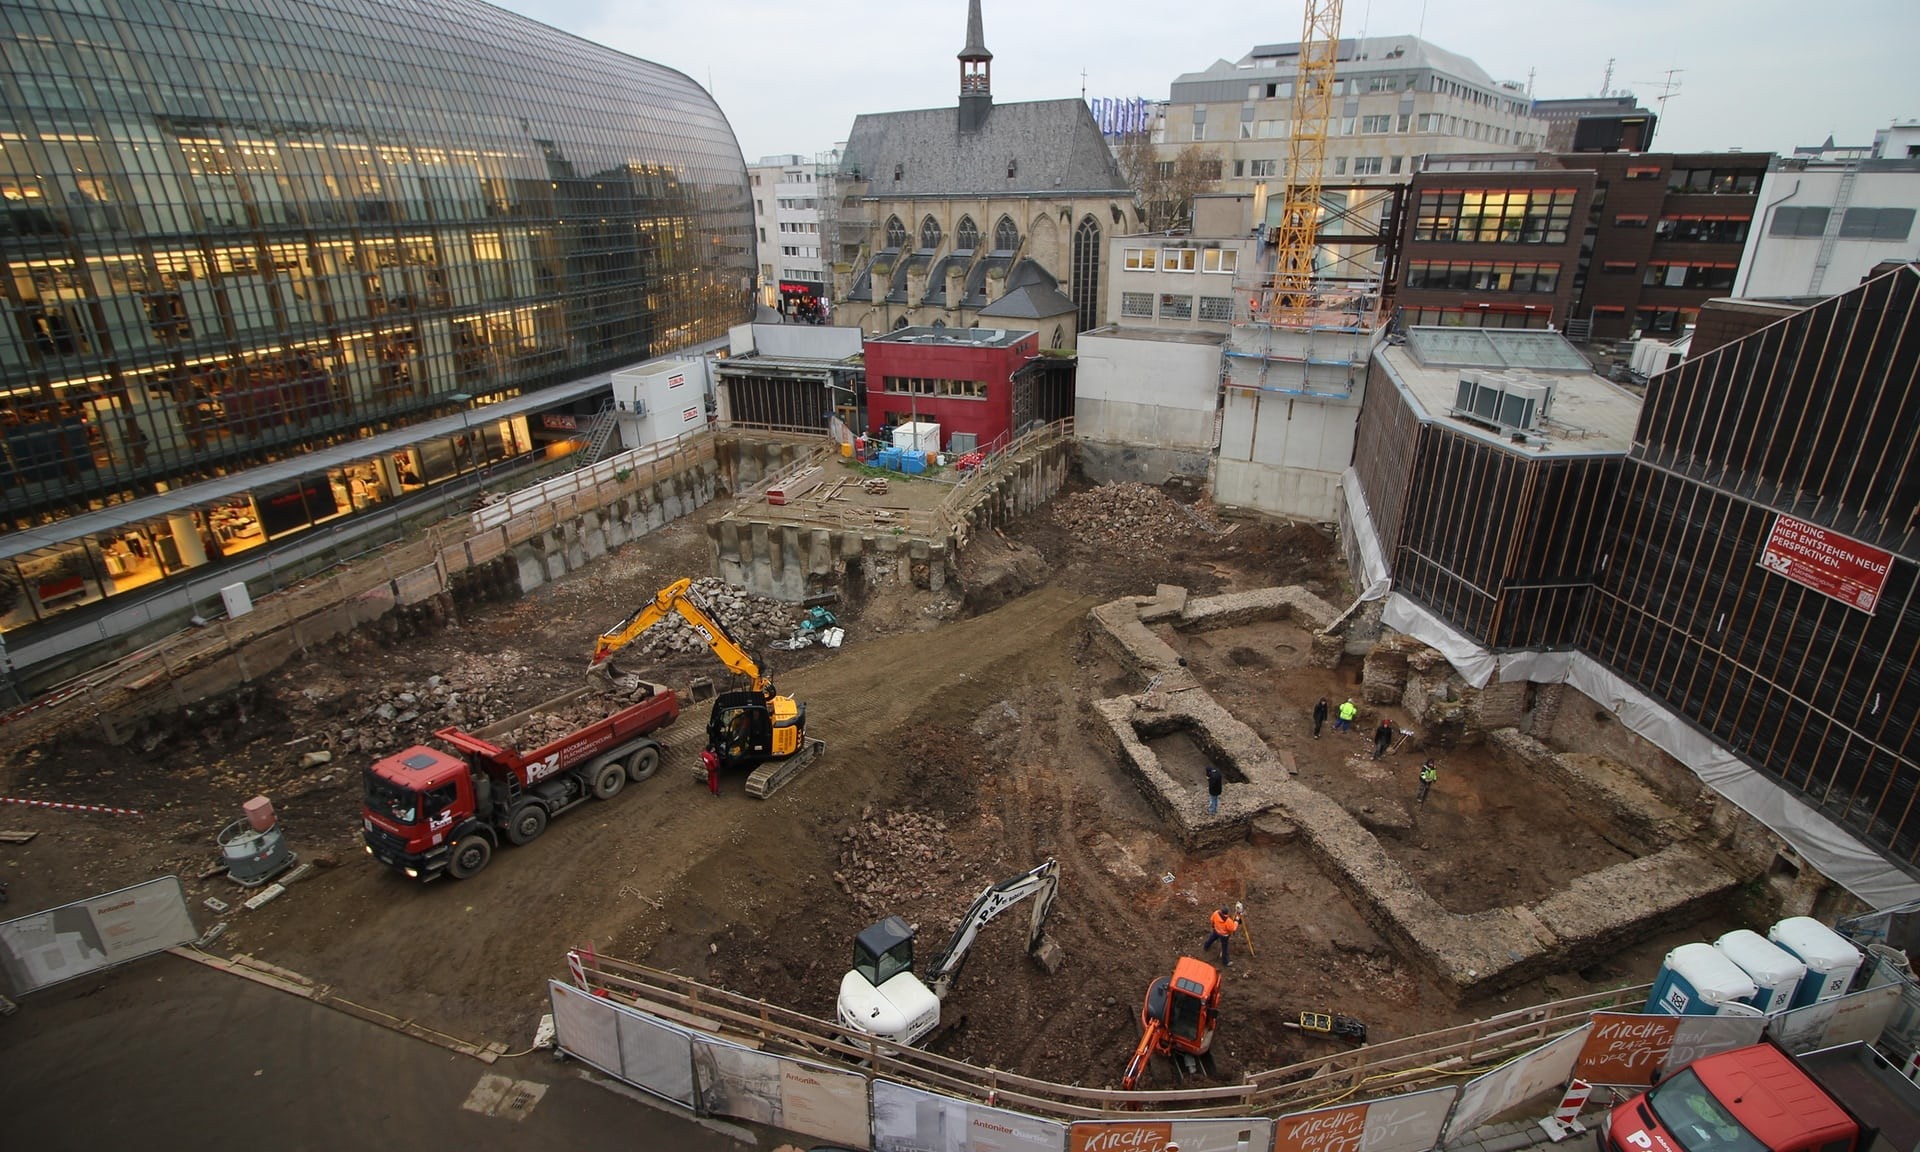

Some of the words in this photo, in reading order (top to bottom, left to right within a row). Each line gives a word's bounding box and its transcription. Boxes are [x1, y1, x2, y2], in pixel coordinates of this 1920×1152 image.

[1778, 516, 1825, 540] ACHTUNG.
[1771, 535, 1840, 569] PERSPEKTIVEN.
[1775, 526, 1798, 540] HIER
[1799, 536, 1854, 562] ENTSTEHEN
[1855, 557, 1886, 575] NEUE
[1763, 552, 1792, 574] P&Z
[695, 624, 713, 641] JCB
[526, 752, 560, 785] P&Z
[1597, 1021, 1669, 1039] KIRCHE
[1584, 1057, 1596, 1066] IN
[1624, 1040, 1737, 1068] STADT
[1609, 1040, 1652, 1052] PLATZ
[1288, 1111, 1360, 1140] KIRCHE
[1084, 1127, 1163, 1151] KIRCHE
[1301, 1130, 1344, 1150] PLATZ
